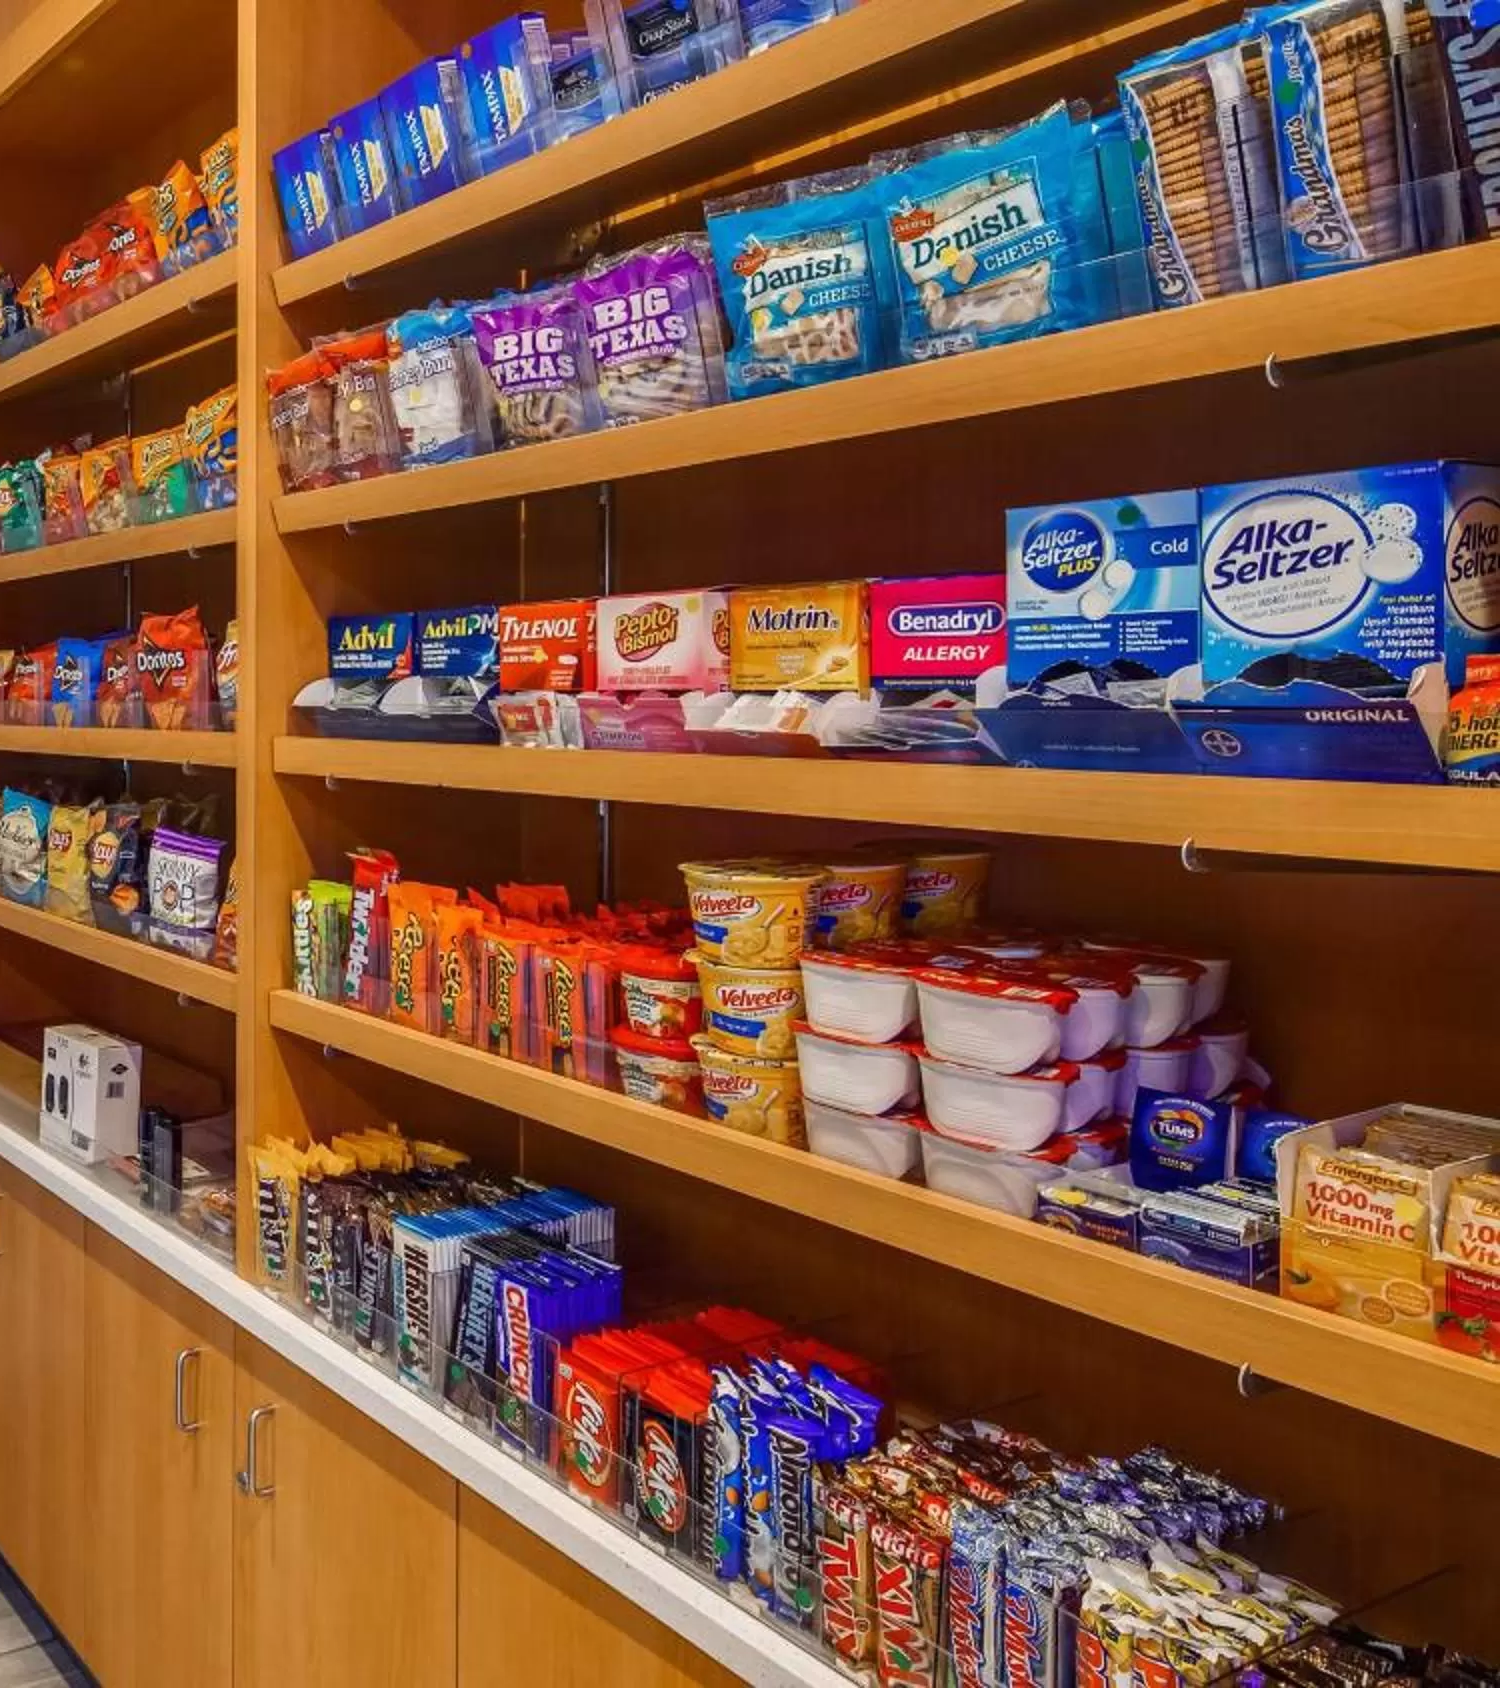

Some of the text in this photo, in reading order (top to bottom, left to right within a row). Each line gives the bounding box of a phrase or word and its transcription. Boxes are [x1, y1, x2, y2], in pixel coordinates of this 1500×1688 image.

[639, 13, 694, 46] ChapStick
[481, 70, 507, 144] TAMPAX
[405, 110, 431, 177] TAMPAX
[1284, 114, 1351, 251] Grandma's
[291, 173, 315, 236] TAMPAX
[911, 200, 1029, 269] Danish
[982, 229, 1061, 272] CHEESE
[748, 252, 853, 299] Danish
[593, 286, 671, 332] BIG
[809, 283, 871, 307] CHEESE
[493, 327, 565, 362] BIG
[589, 315, 688, 360] TEXAS
[489, 353, 577, 387] TEXAS
[1022, 539, 1099, 572] Seltzer
[1027, 527, 1085, 552] Alka-
[1150, 537, 1190, 555] Cold
[1218, 518, 1329, 560] Alka-
[1057, 558, 1096, 578] PLUS
[1211, 537, 1356, 590] Seltzer
[1450, 549, 1500, 583] Seltz
[423, 616, 467, 639] Advil
[501, 616, 579, 642] TYLENOL
[615, 604, 680, 640] Pepto-
[747, 603, 832, 634] Motrin
[898, 608, 994, 636] Benadryl
[338, 622, 397, 651] Advil
[621, 620, 680, 655] Bismol
[903, 644, 991, 662] ALLERGY
[137, 650, 185, 673] Doritos
[1304, 707, 1411, 723] ORIGINAL
[693, 894, 757, 914] Velveeta
[719, 986, 798, 1009] Velveeta
[1158, 1121, 1196, 1140] TUMS
[1308, 1181, 1395, 1221] 1,000 mg
[1306, 1200, 1416, 1243] Vitamin C
[354, 1241, 380, 1339] HRSHEY'S
[505, 1285, 531, 1401] CRUNCH
[572, 1381, 605, 1476] KitKa
[766, 1423, 811, 1552] Almond
[816, 1531, 861, 1663] TWIX
[874, 1552, 932, 1688] TWIX
